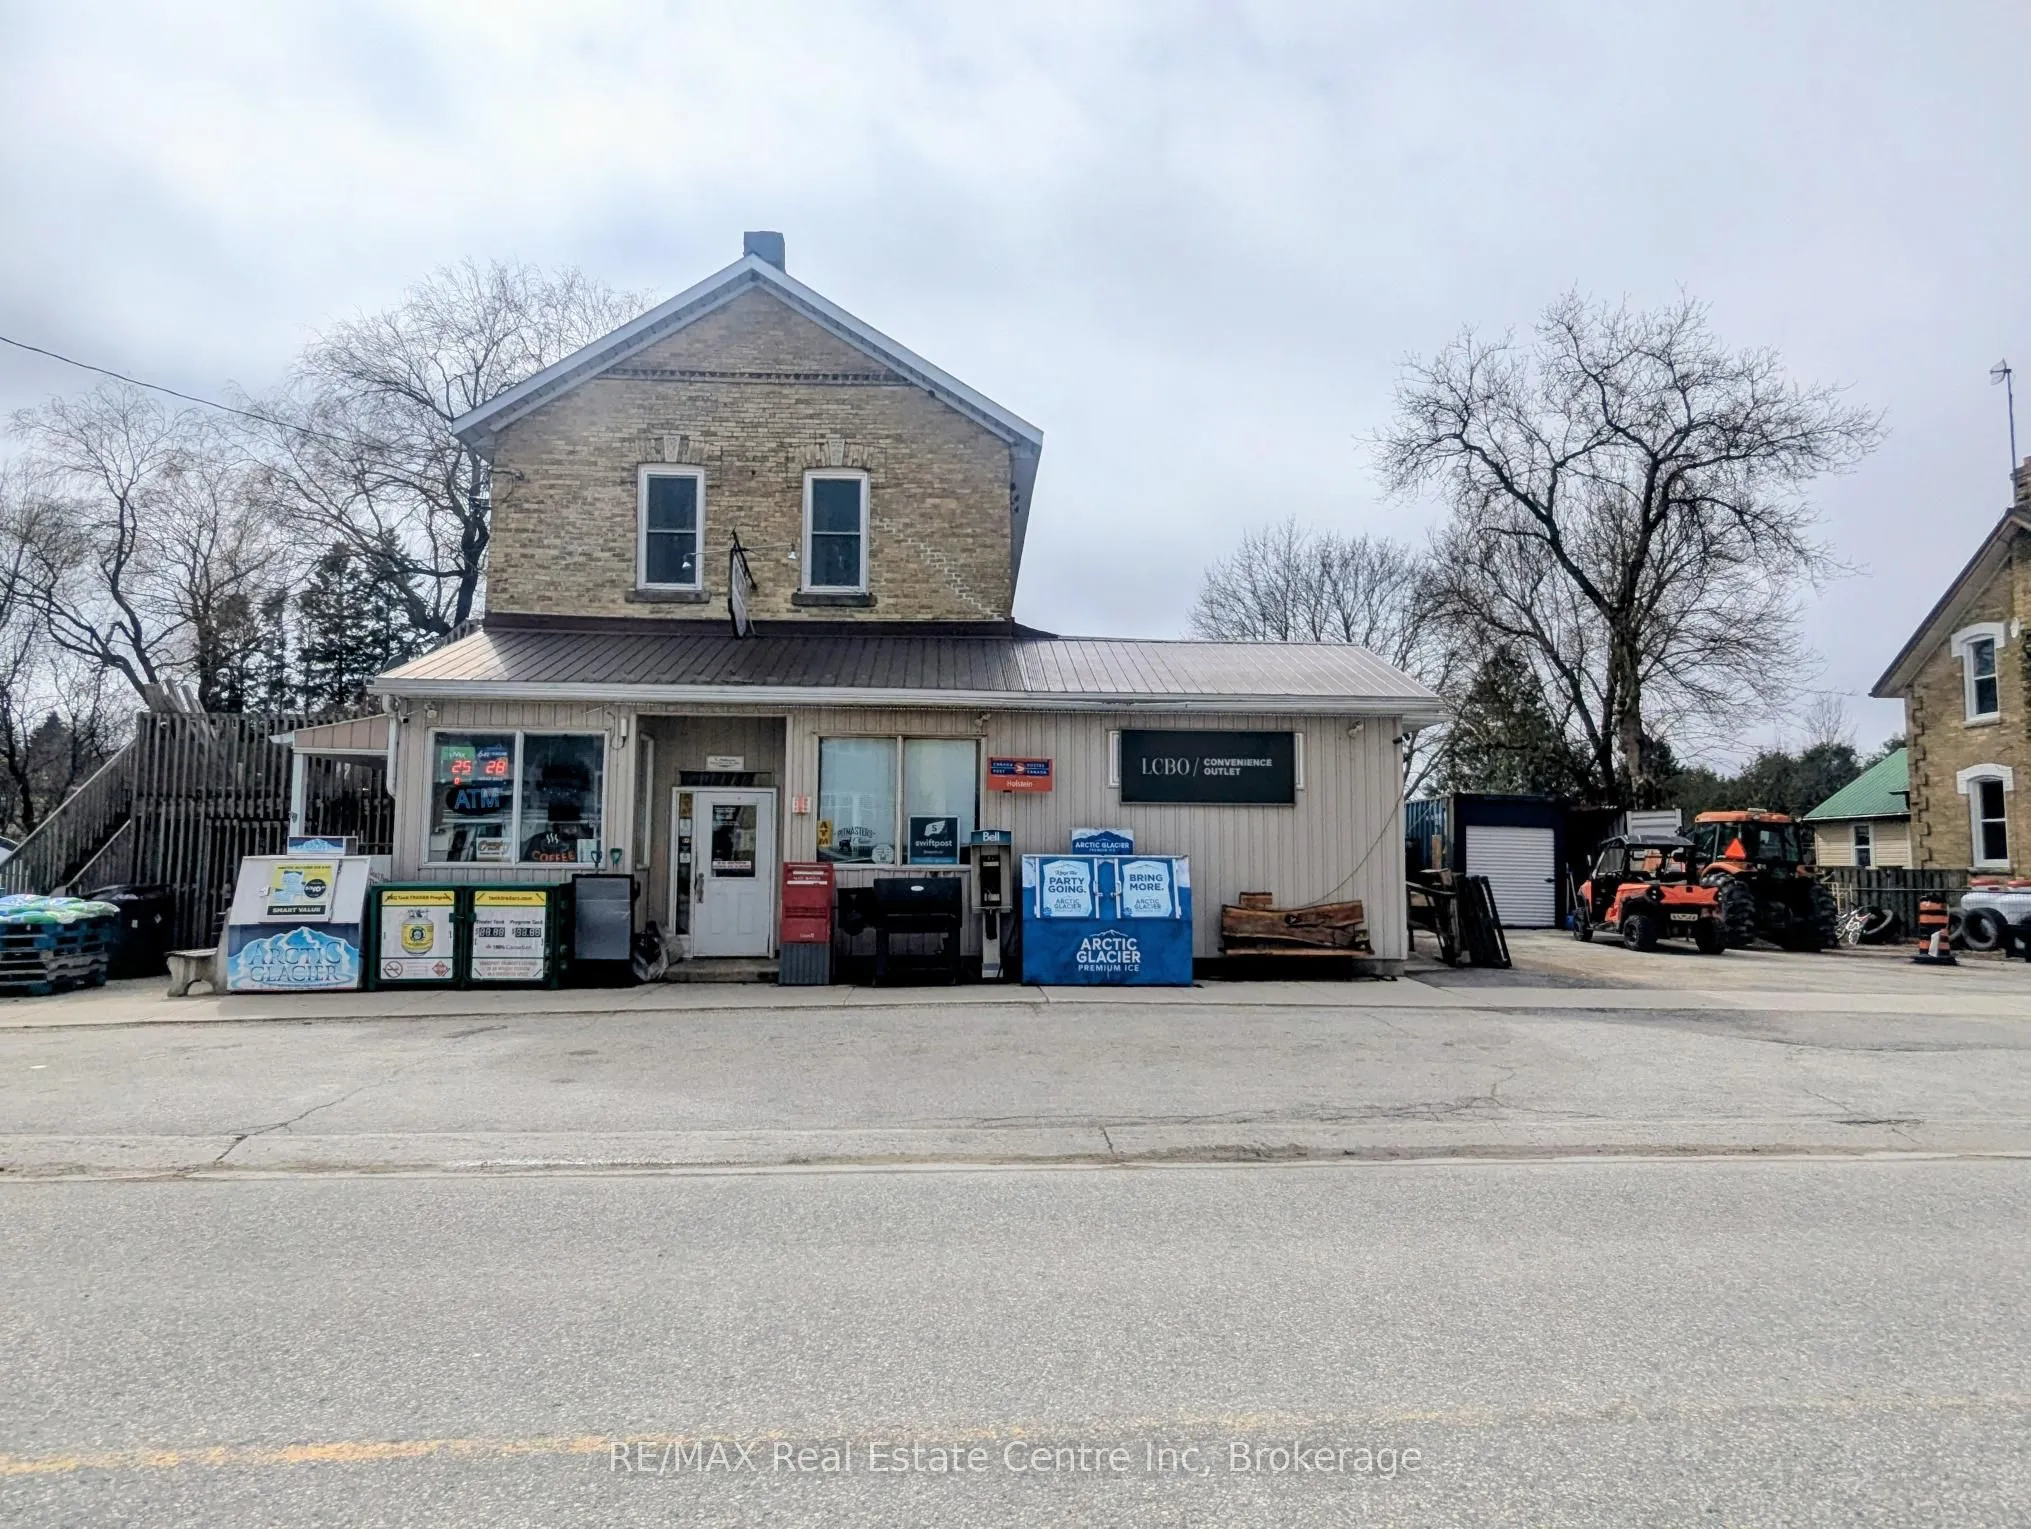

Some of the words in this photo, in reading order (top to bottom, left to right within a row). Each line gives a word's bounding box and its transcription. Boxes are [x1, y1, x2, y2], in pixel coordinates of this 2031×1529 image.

[451, 760, 472, 774] 25
[485, 760, 507, 775] 28
[1141, 757, 1190, 776] LCBO
[1203, 758, 1273, 767] CONVENIENCE
[1203, 767, 1241, 776] OUTLET
[1006, 780, 1033, 788] Holstein
[454, 787, 500, 810] ATM
[982, 831, 1001, 842] Bell
[915, 838, 953, 848] swiftpost
[531, 850, 577, 863] COFFEE
[1049, 877, 1085, 885] PARTY
[1129, 874, 1163, 882] BRING
[1129, 883, 1164, 891] MORE.
[1080, 938, 1137, 950] ARCTIC
[249, 941, 342, 965] ARCTIC
[1076, 951, 1141, 963] GLACIER
[250, 965, 339, 982] GLACIER
